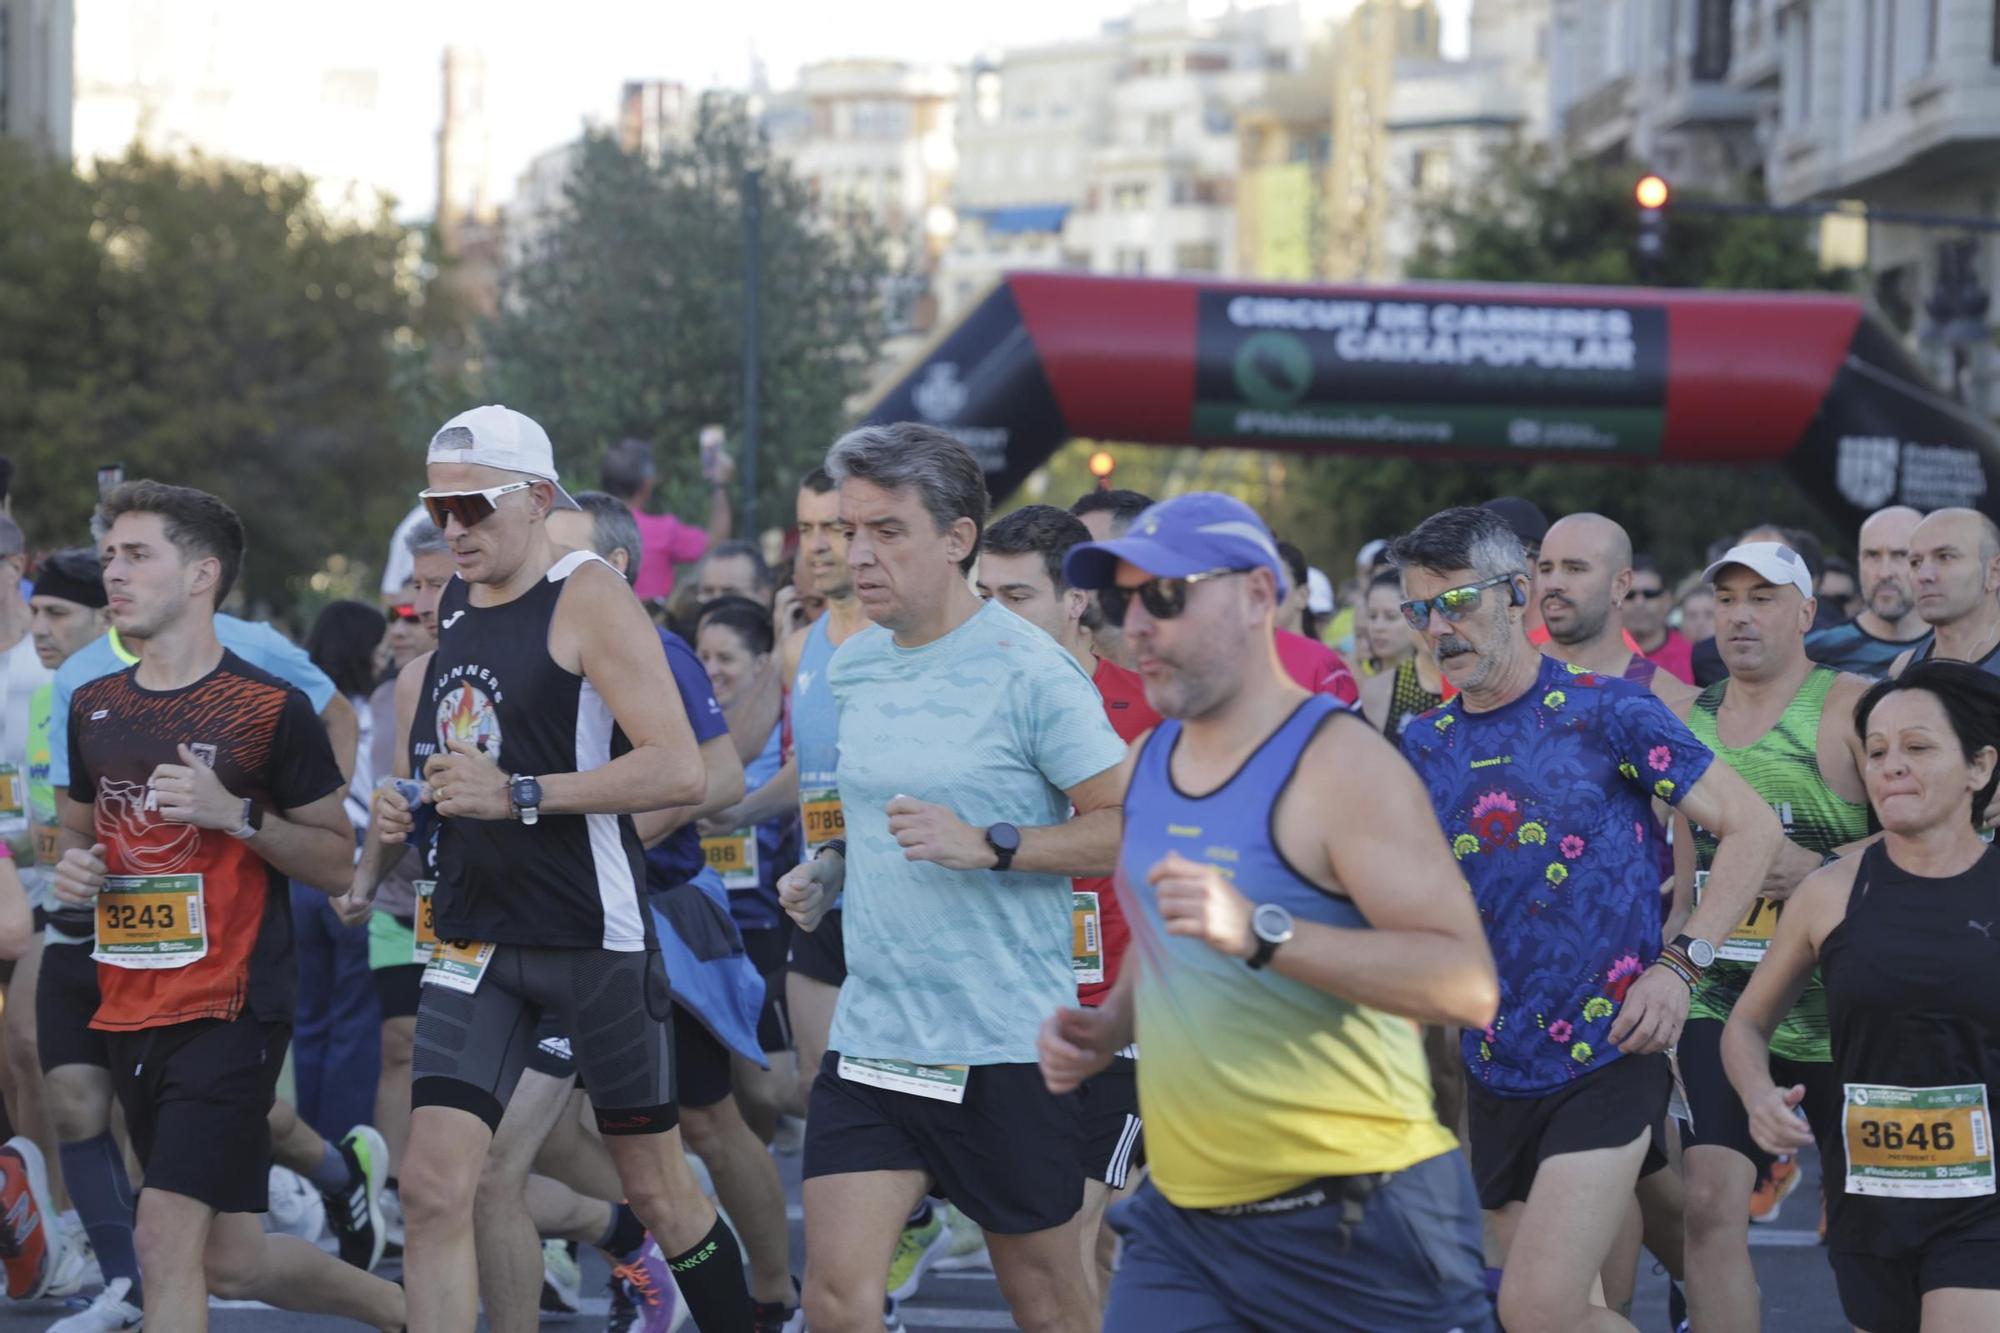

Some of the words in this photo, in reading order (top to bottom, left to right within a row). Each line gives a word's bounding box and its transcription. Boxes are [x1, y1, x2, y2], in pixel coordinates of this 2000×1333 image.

[1229, 297, 1370, 328] CIRCUIT
[1375, 303, 1428, 330] DE
[1334, 329, 1456, 364] CAIXA
[1458, 334, 1635, 369] POPULAR
[106, 904, 174, 929] 3243
[1861, 1120, 1955, 1151] 3646
